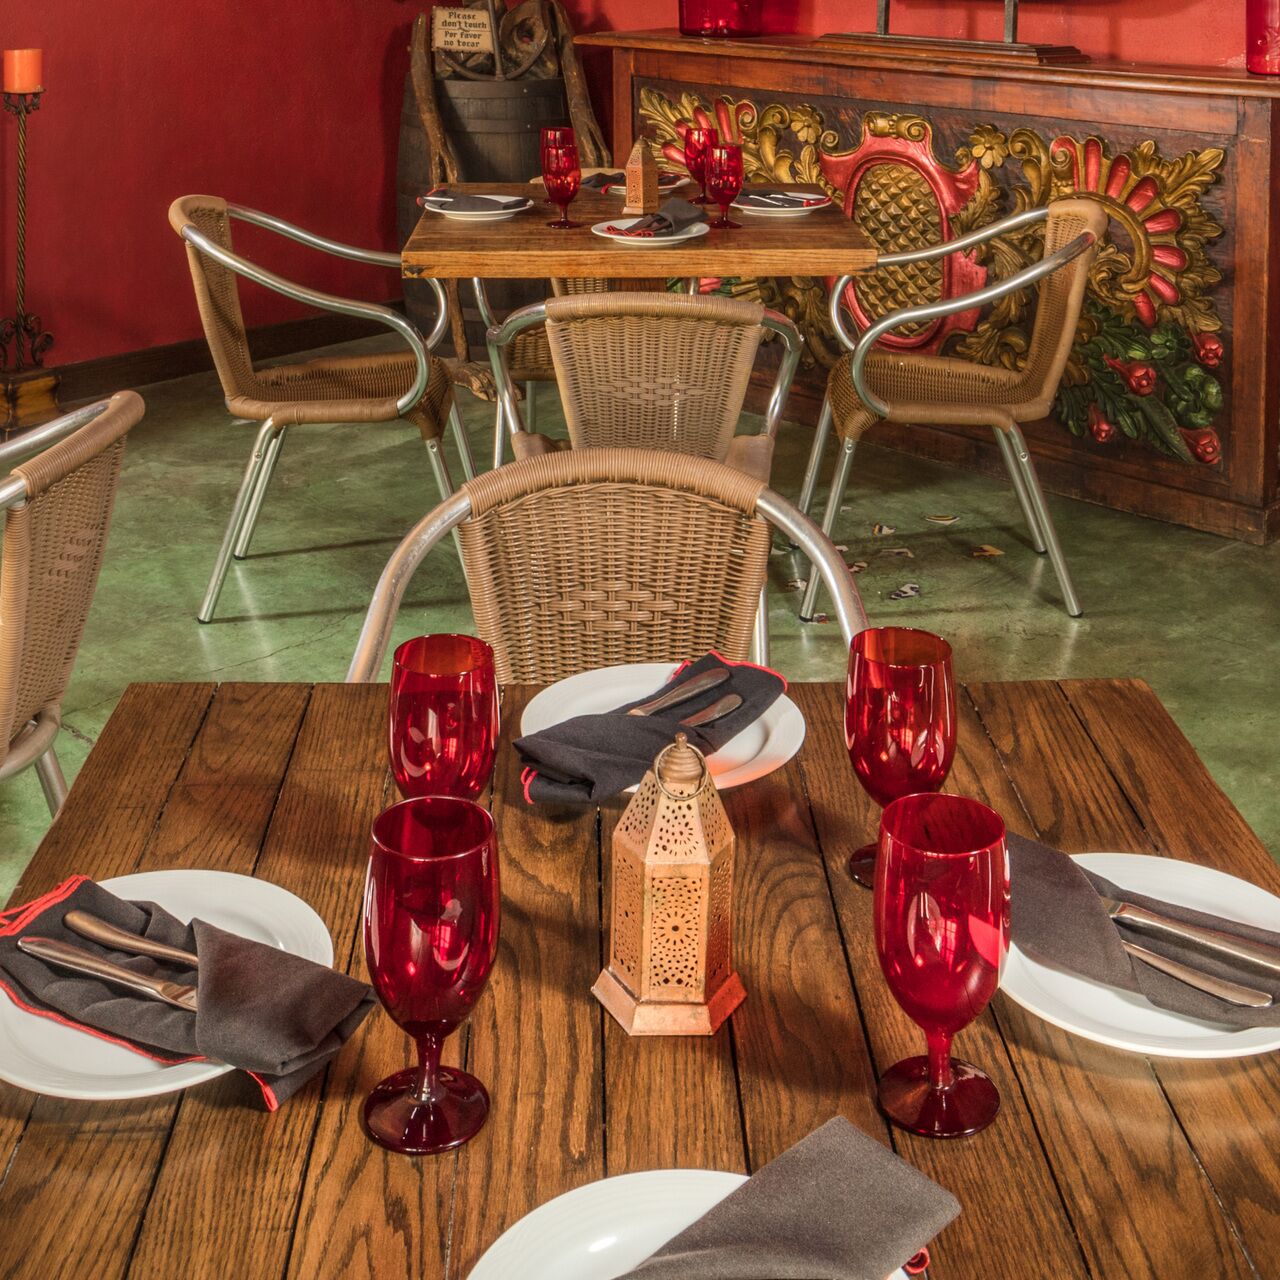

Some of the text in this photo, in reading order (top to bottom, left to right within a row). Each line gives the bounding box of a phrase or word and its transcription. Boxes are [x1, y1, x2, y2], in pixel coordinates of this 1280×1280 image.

[448, 11, 477, 20] Please
[464, 20, 487, 29] touch
[444, 30, 483, 40] Por favor
[443, 39, 480, 48] no tocar
